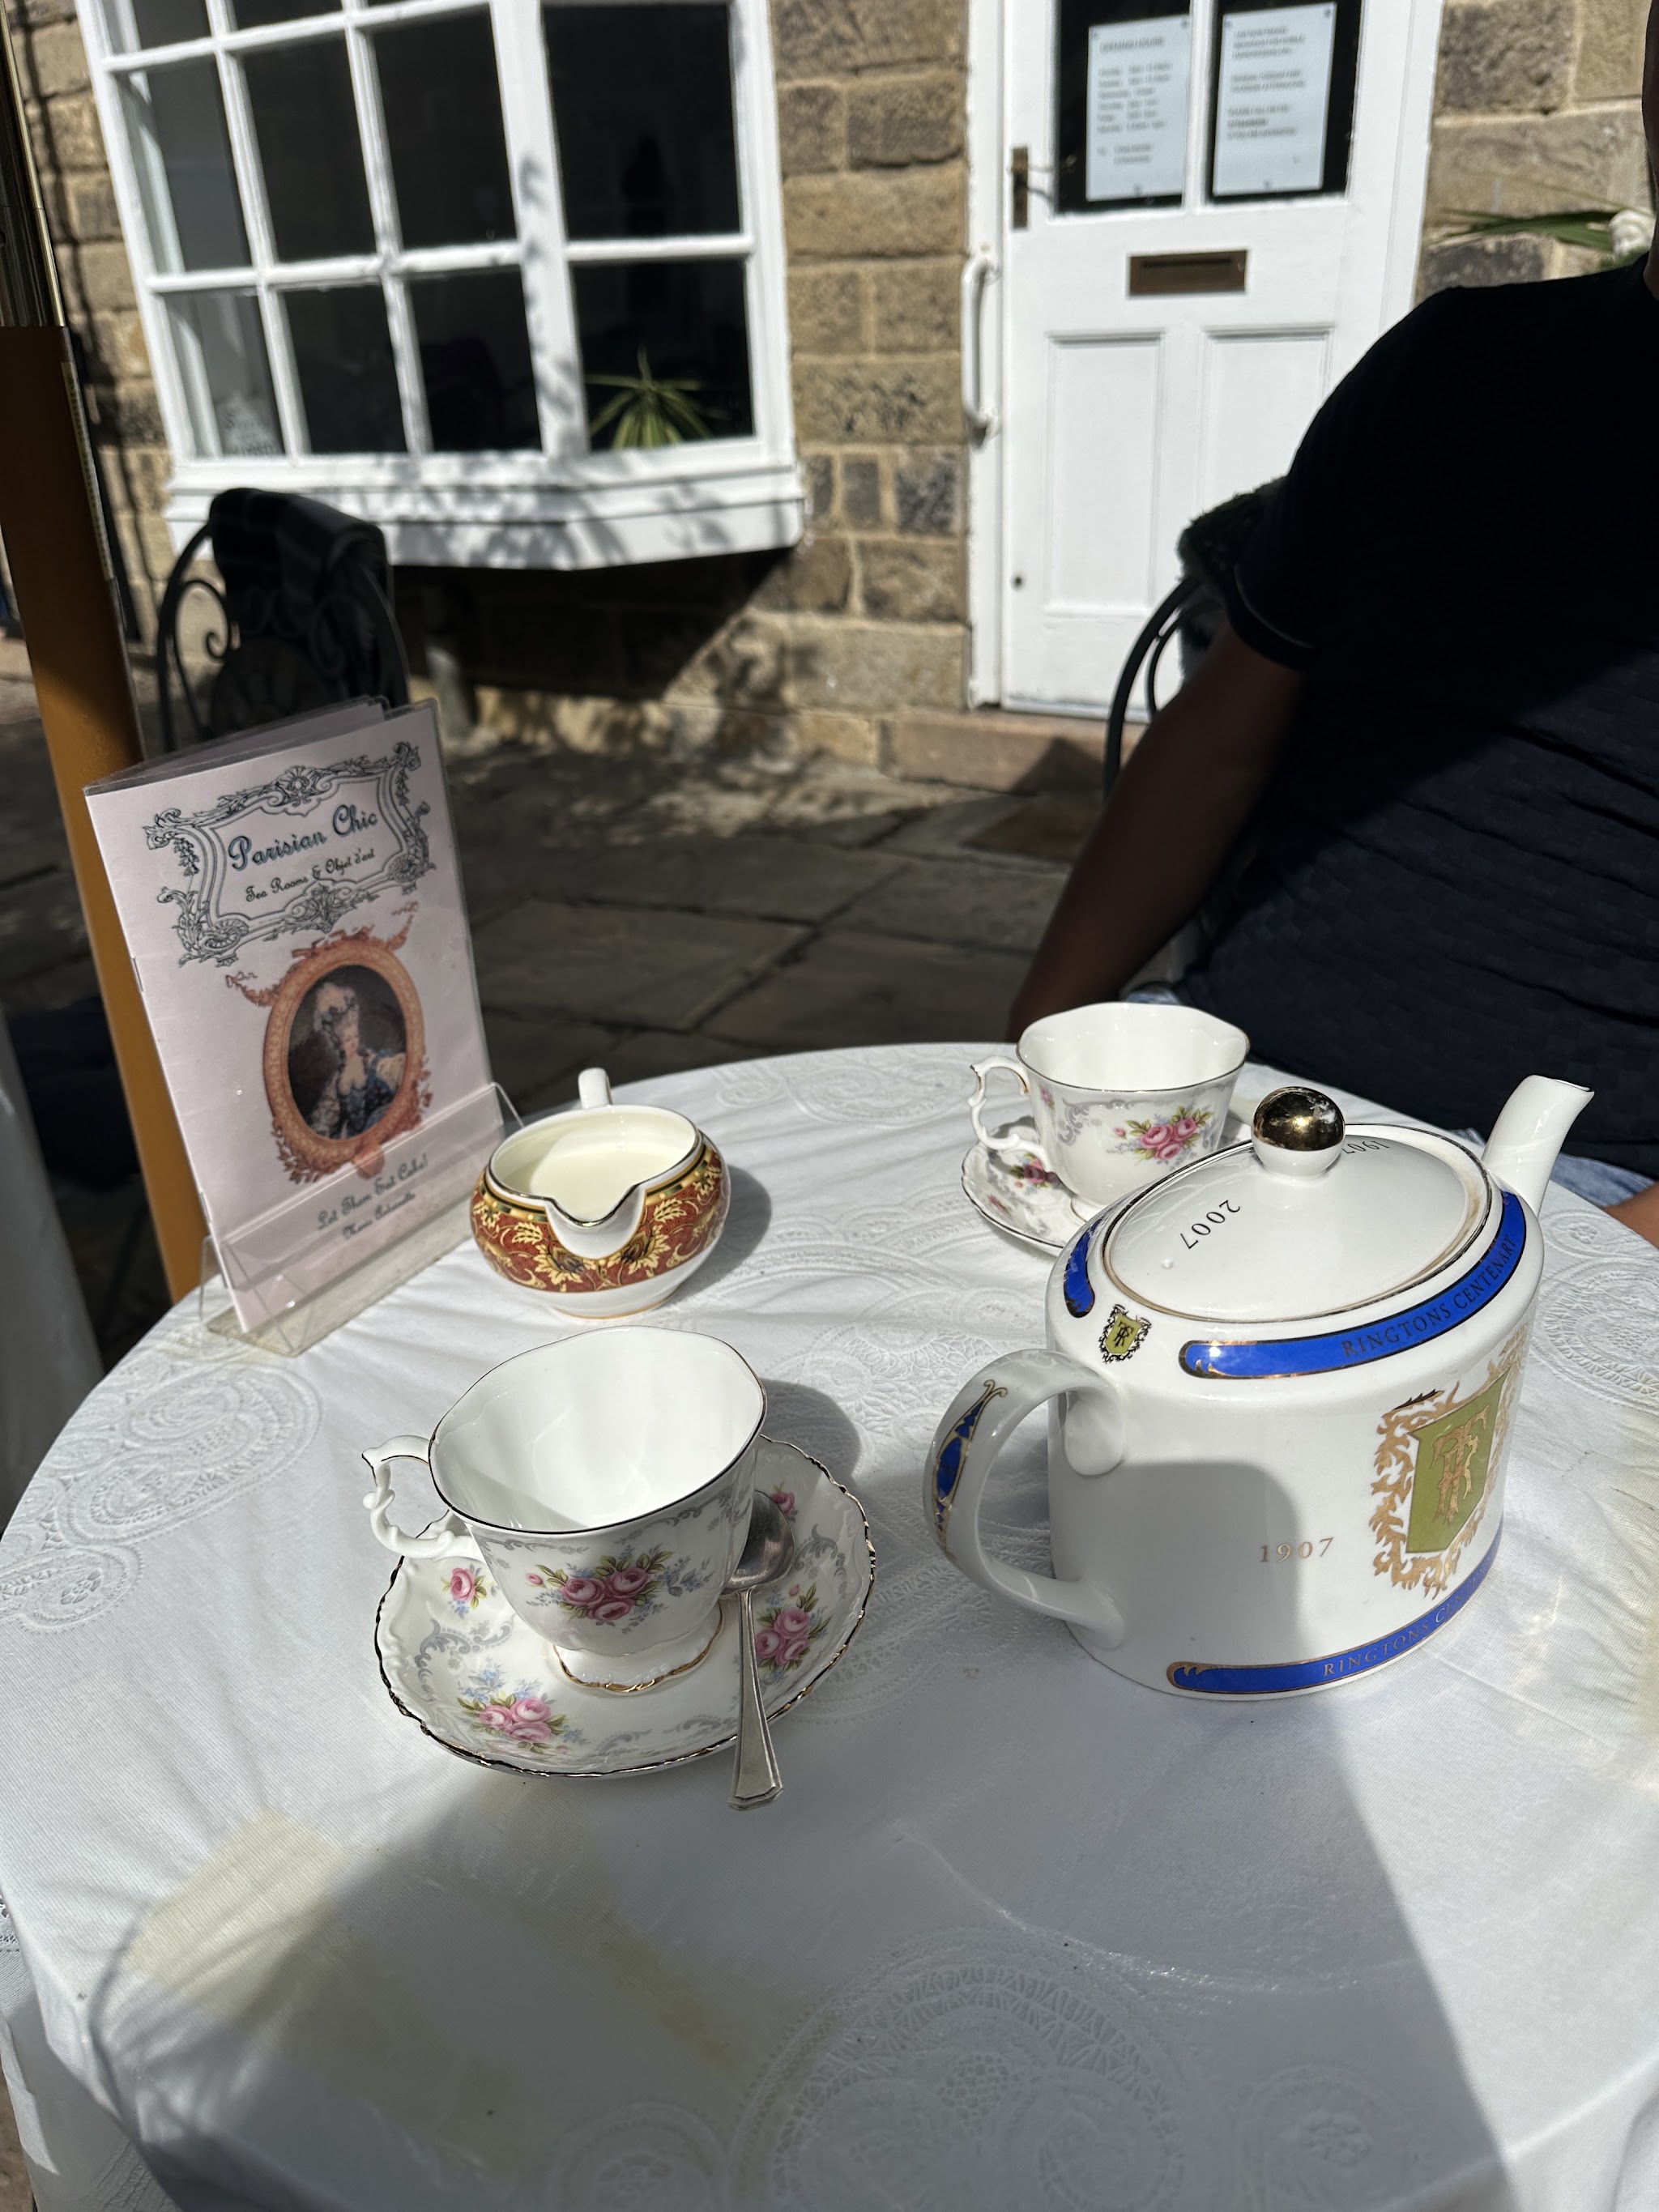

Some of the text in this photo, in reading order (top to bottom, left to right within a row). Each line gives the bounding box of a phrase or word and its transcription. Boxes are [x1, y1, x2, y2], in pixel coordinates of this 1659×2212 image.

[228, 803, 378, 871] Parisian Chic
[245, 885, 268, 902] Tea
[271, 876, 309, 893] Rooms
[312, 865, 322, 880] &
[1341, 1140, 1390, 1154] 1907
[341, 1194, 373, 1216] Them
[1180, 1200, 1241, 1250] 2007
[1341, 1234, 1517, 1357] RINGTONS CENTENARY
[1260, 1536, 1334, 1563] 1907
[1322, 1621, 1430, 1677] RINGTONS
